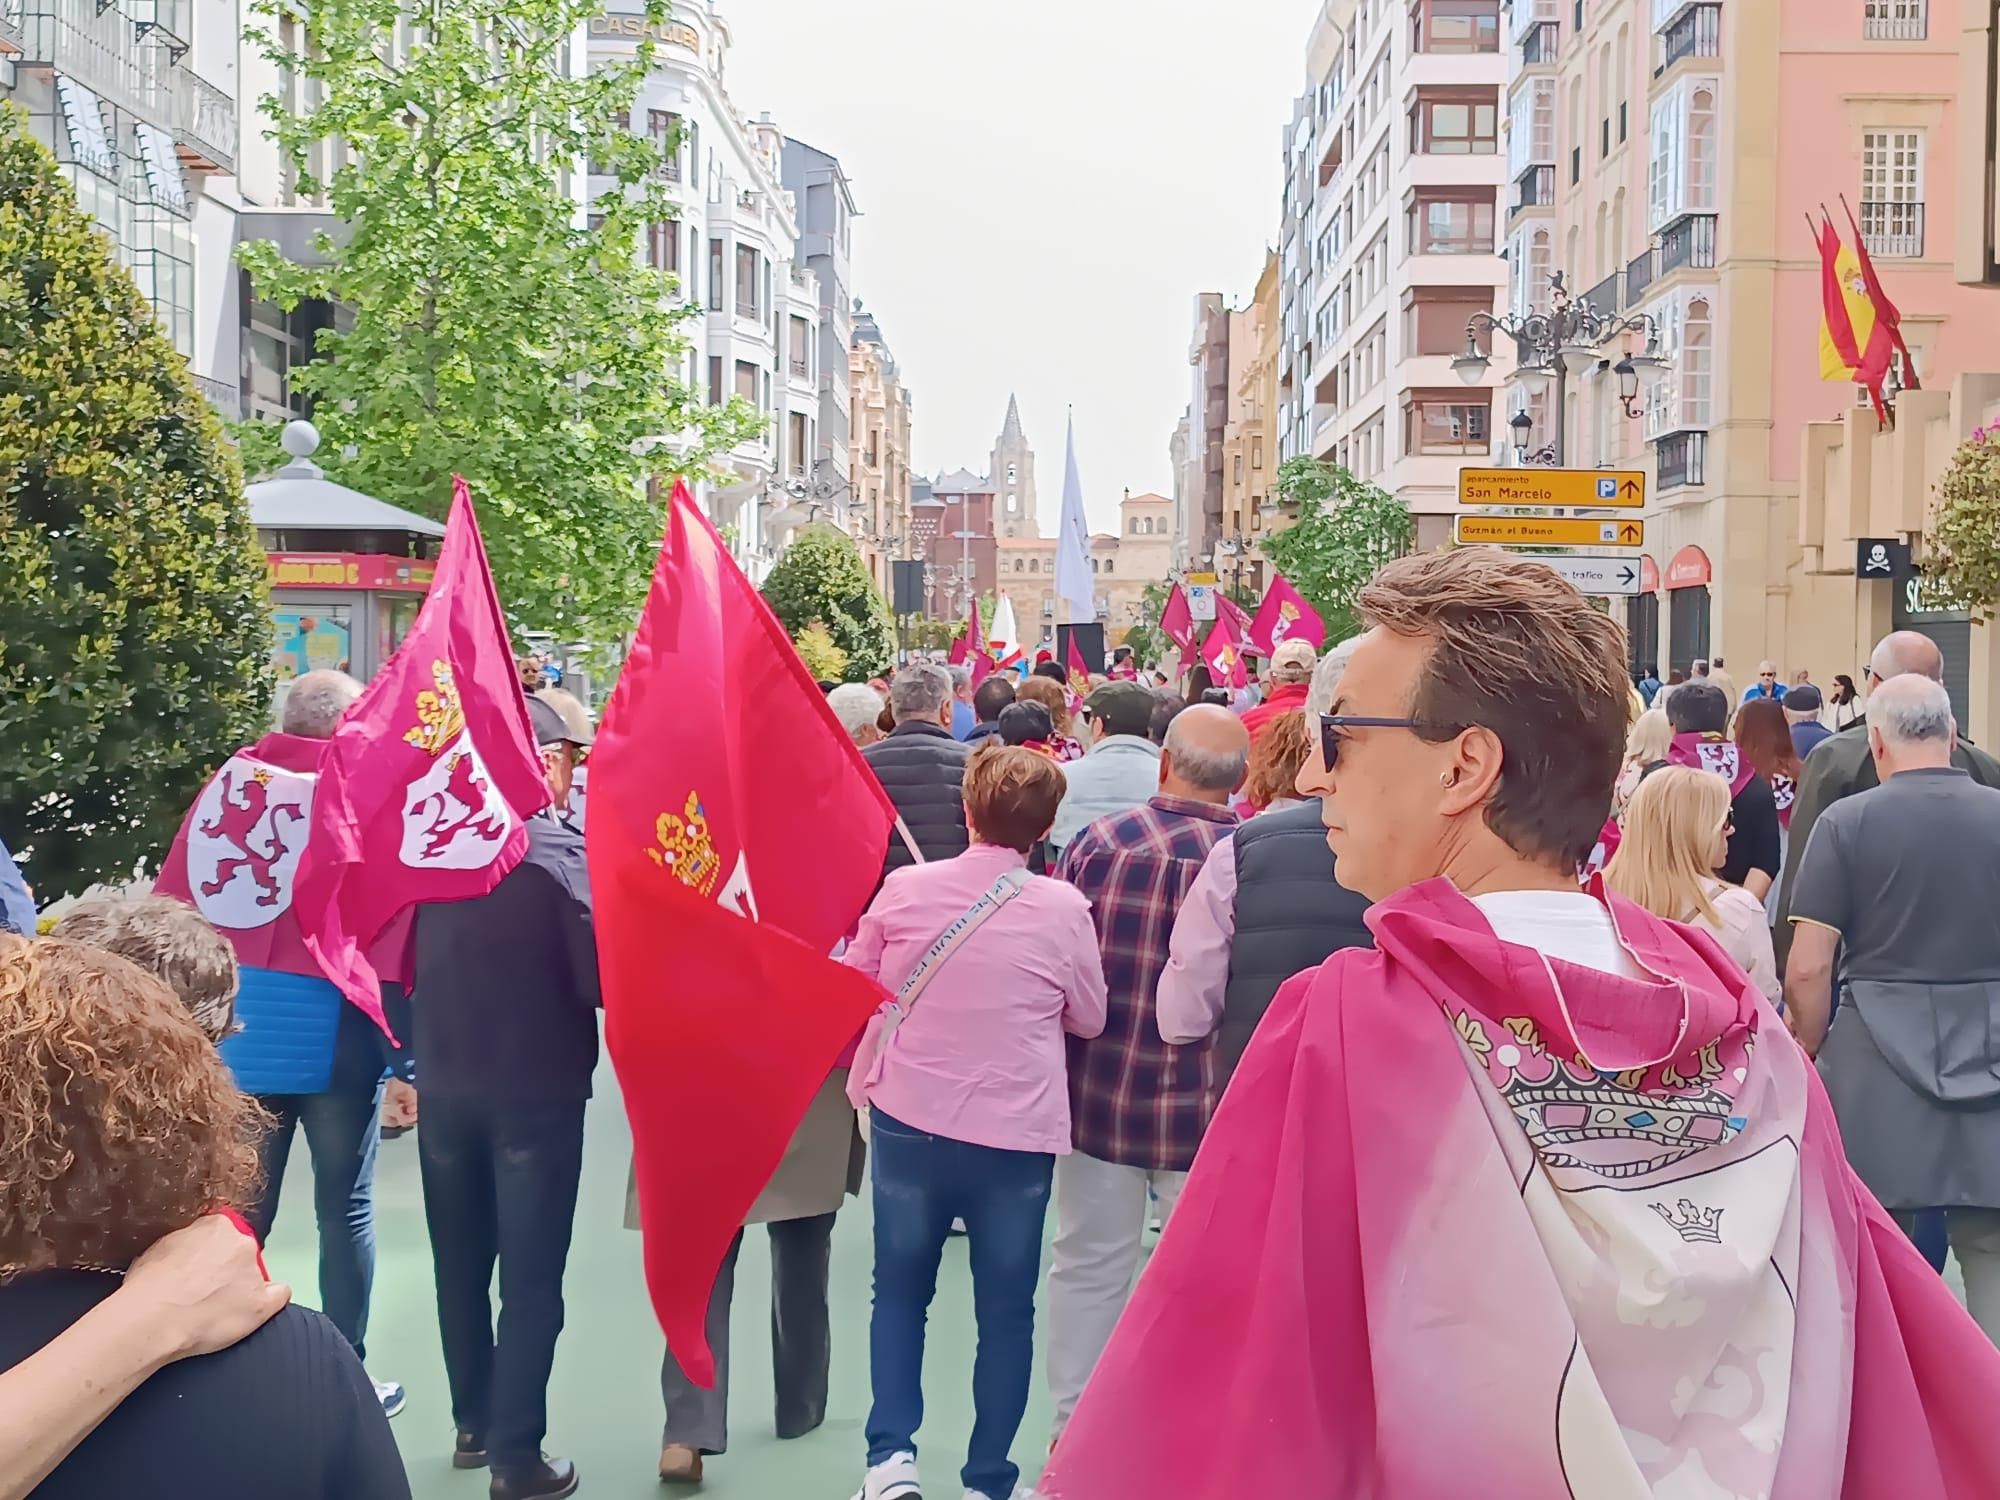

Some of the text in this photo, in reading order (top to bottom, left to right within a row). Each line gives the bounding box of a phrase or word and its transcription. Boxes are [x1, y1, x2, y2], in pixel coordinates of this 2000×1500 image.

[590, 16, 654, 38] CASA
[1466, 487, 1491, 498] San
[1498, 487, 1552, 499] Marcelo
[1507, 527, 1516, 535] el
[1520, 526, 1553, 535] Bueno
